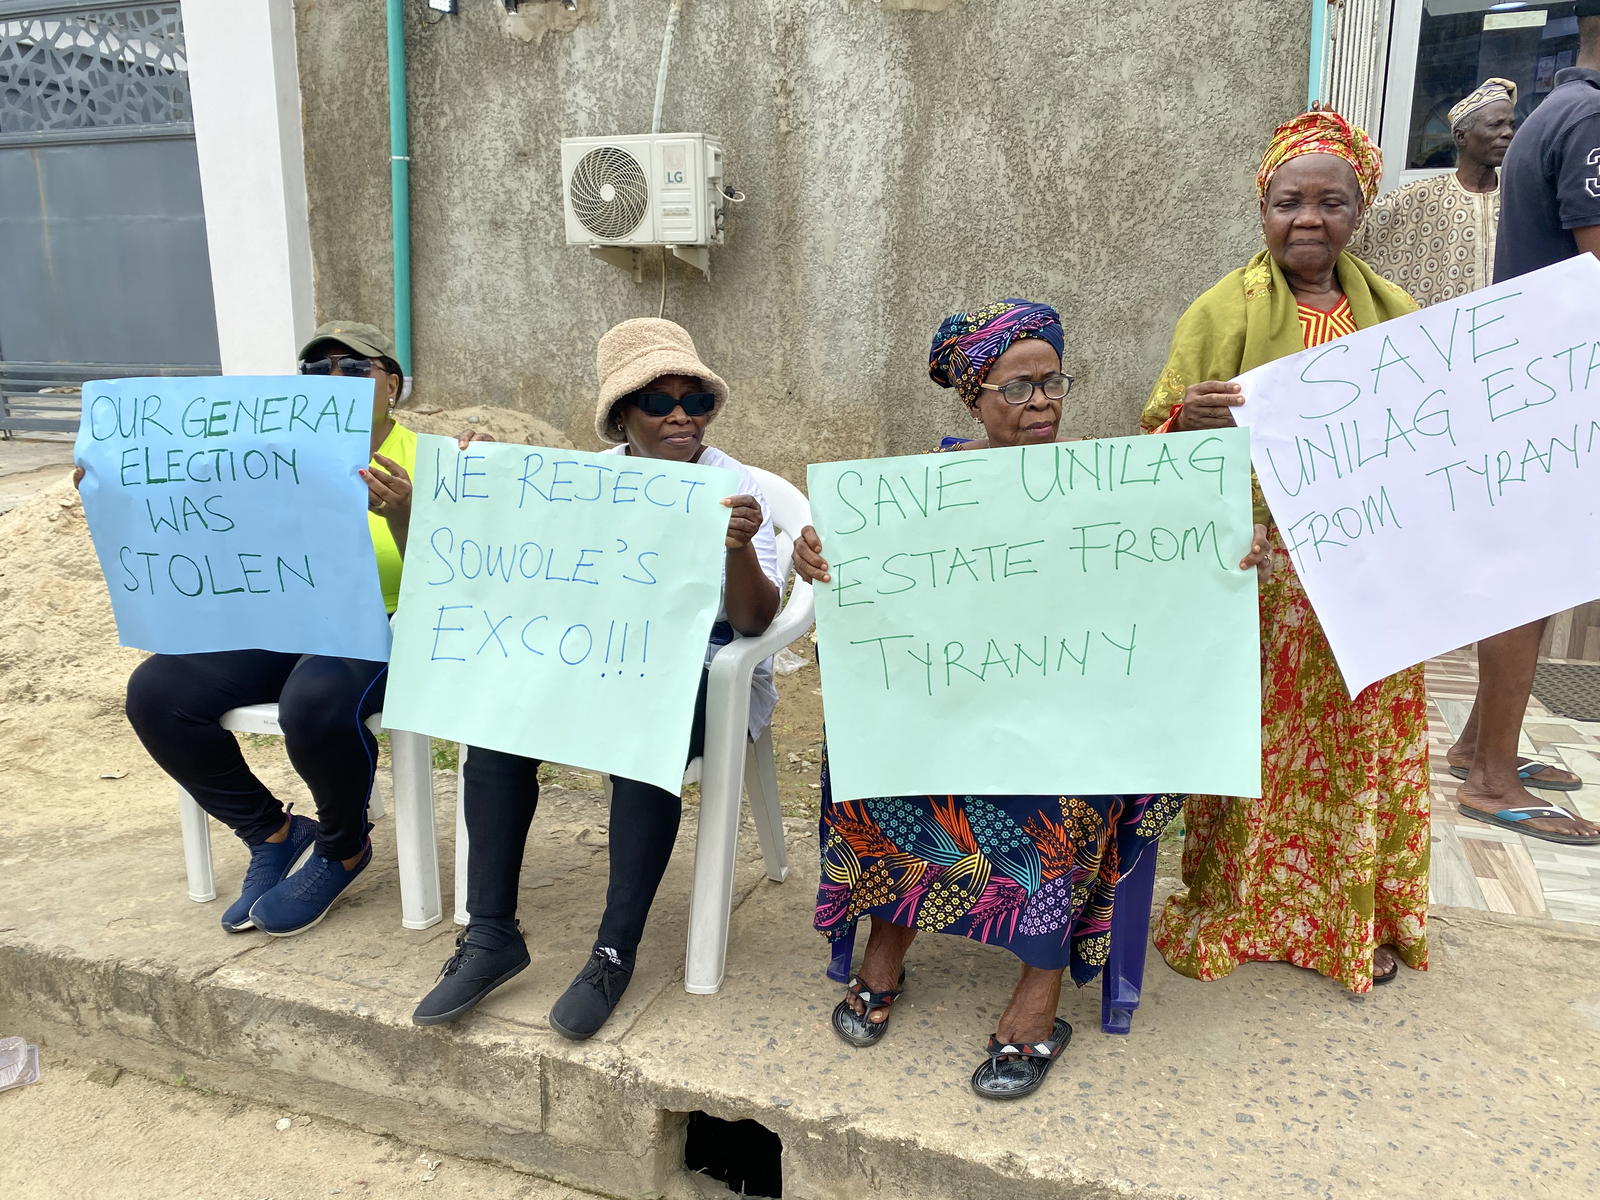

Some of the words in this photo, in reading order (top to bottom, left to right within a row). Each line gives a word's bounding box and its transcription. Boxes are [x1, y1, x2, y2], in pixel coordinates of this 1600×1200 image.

[667, 171, 683, 183] LG
[1299, 292, 1523, 419] SAVE
[90, 394, 174, 441] OUR
[181, 394, 370, 438] GENERAL
[1266, 389, 1457, 497] UNILAG
[120, 447, 300, 486] ELECTION
[433, 447, 489, 503] WE
[518, 453, 706, 513] REJECT
[835, 458, 988, 535] SAVE
[1021, 437, 1225, 503] UNILAG
[146, 495, 235, 534] WAS
[1287, 485, 1404, 574] FROM
[119, 546, 315, 597] STOLEN
[428, 527, 659, 585] SOWOLE'S
[832, 539, 1045, 608] ESTATE
[1069, 520, 1231, 572] FROM
[431, 605, 649, 678] EXCO!!!
[850, 624, 1137, 696] TYRANNY
